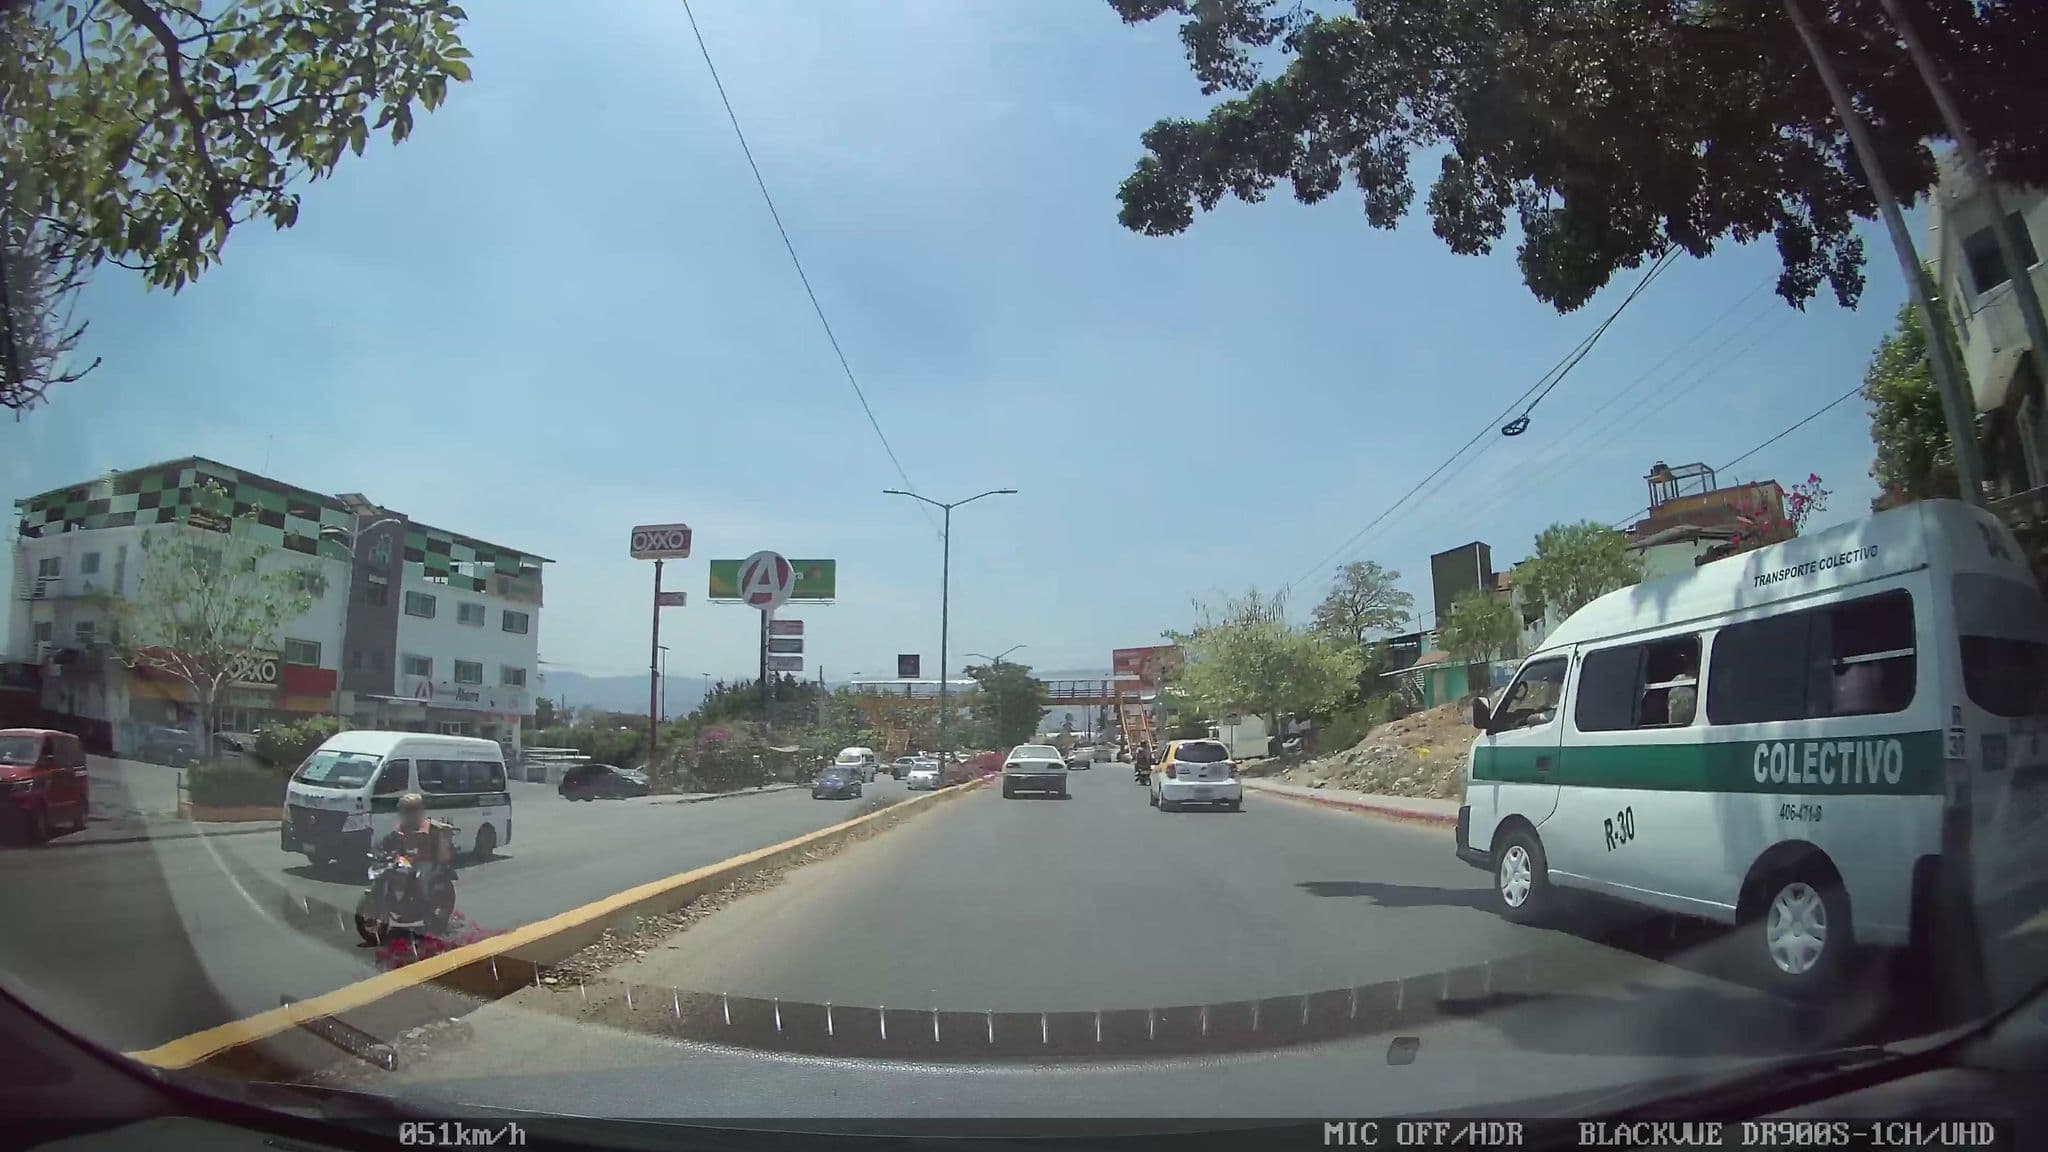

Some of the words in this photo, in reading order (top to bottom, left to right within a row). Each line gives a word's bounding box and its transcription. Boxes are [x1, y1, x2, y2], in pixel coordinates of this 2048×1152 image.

[633, 529, 684, 551] OXXO
[1753, 560, 1817, 588] TRANSPORTE
[1819, 545, 1878, 571] COLECTIVO
[1753, 738, 1903, 785] COLECTIVO
[1603, 805, 1635, 852] R-30
